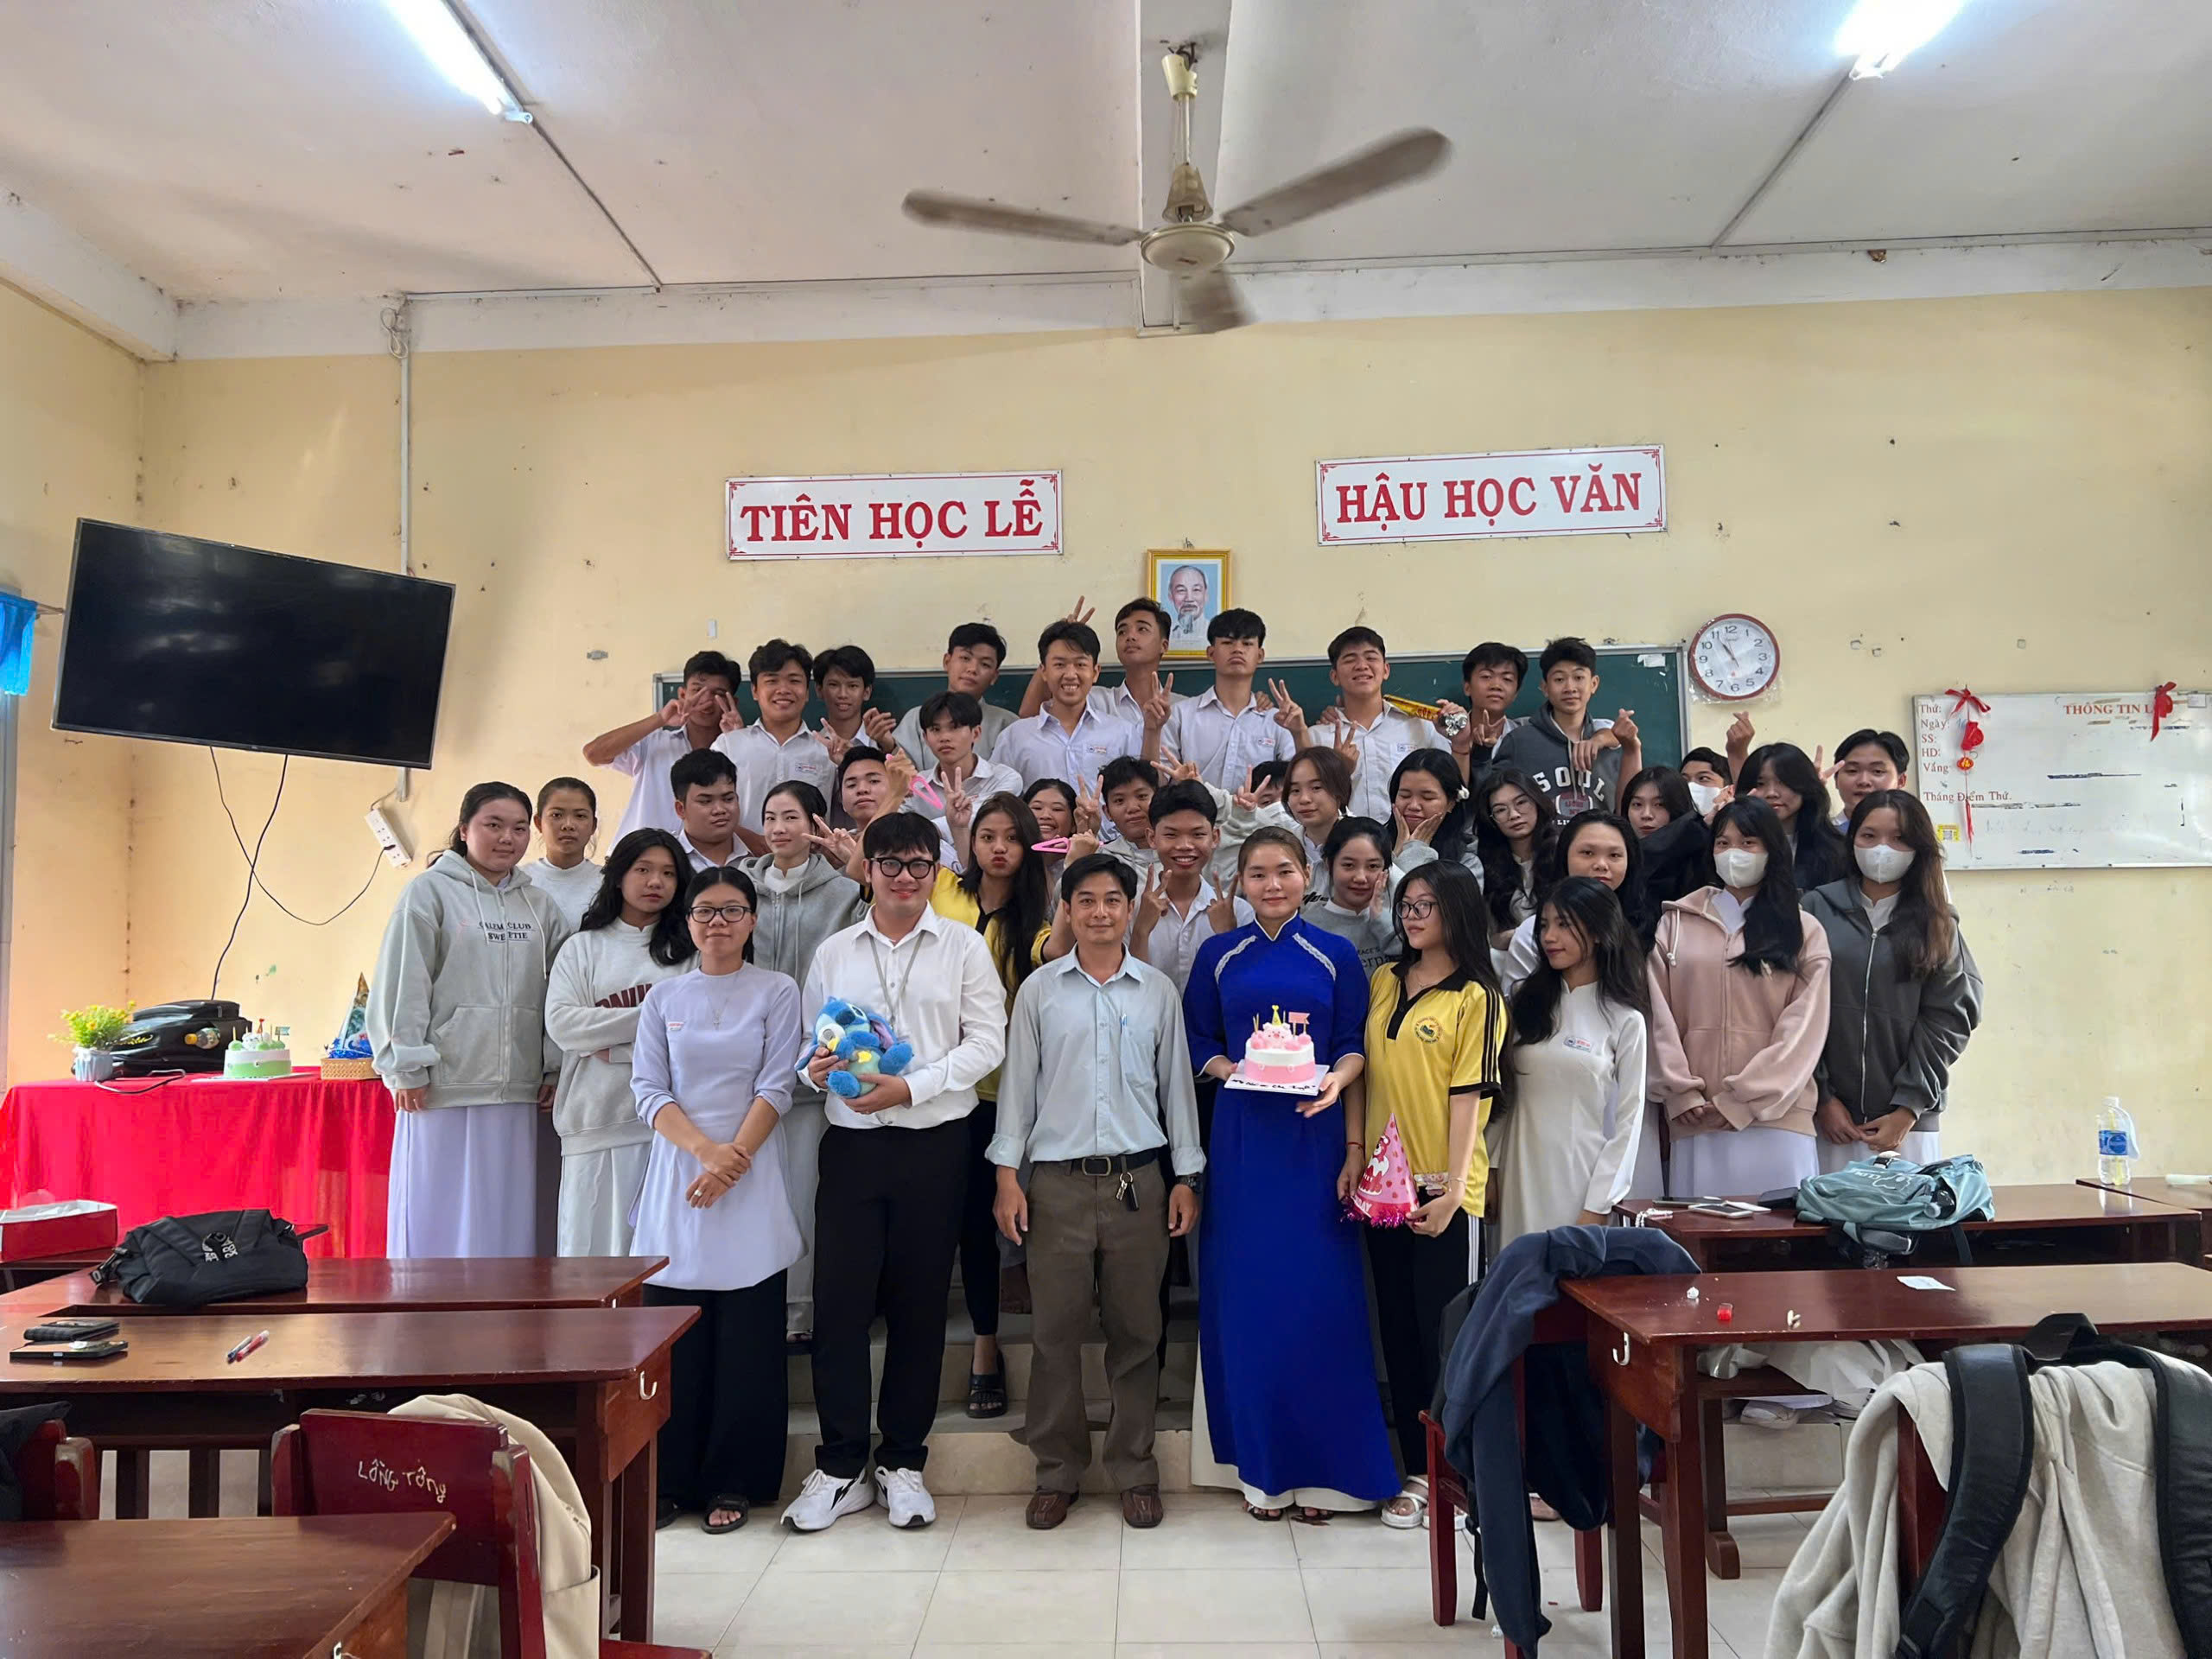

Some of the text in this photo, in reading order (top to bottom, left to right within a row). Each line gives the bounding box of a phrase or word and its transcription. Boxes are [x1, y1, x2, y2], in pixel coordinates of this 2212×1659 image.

[1336, 462, 1643, 531] HẬU HỌC VĂN
[740, 479, 1043, 549] TIÊN HỌC LỄ
[1725, 625, 1738, 634] 12
[1745, 628, 1750, 637] 1
[1711, 630, 1720, 639] 11
[1701, 641, 1713, 650] 10
[1754, 639, 1764, 647] 2
[1699, 655, 1708, 664] 9
[1758, 652, 1768, 661] 3
[1755, 667, 1764, 676] 4
[1715, 679, 1724, 689] 7
[1745, 677, 1755, 687] 5
[1730, 683, 1740, 692] 6
[2063, 702, 2113, 715] THÔNG
[2117, 703, 2141, 714] TIN
[1923, 791, 1955, 803] Tháng
